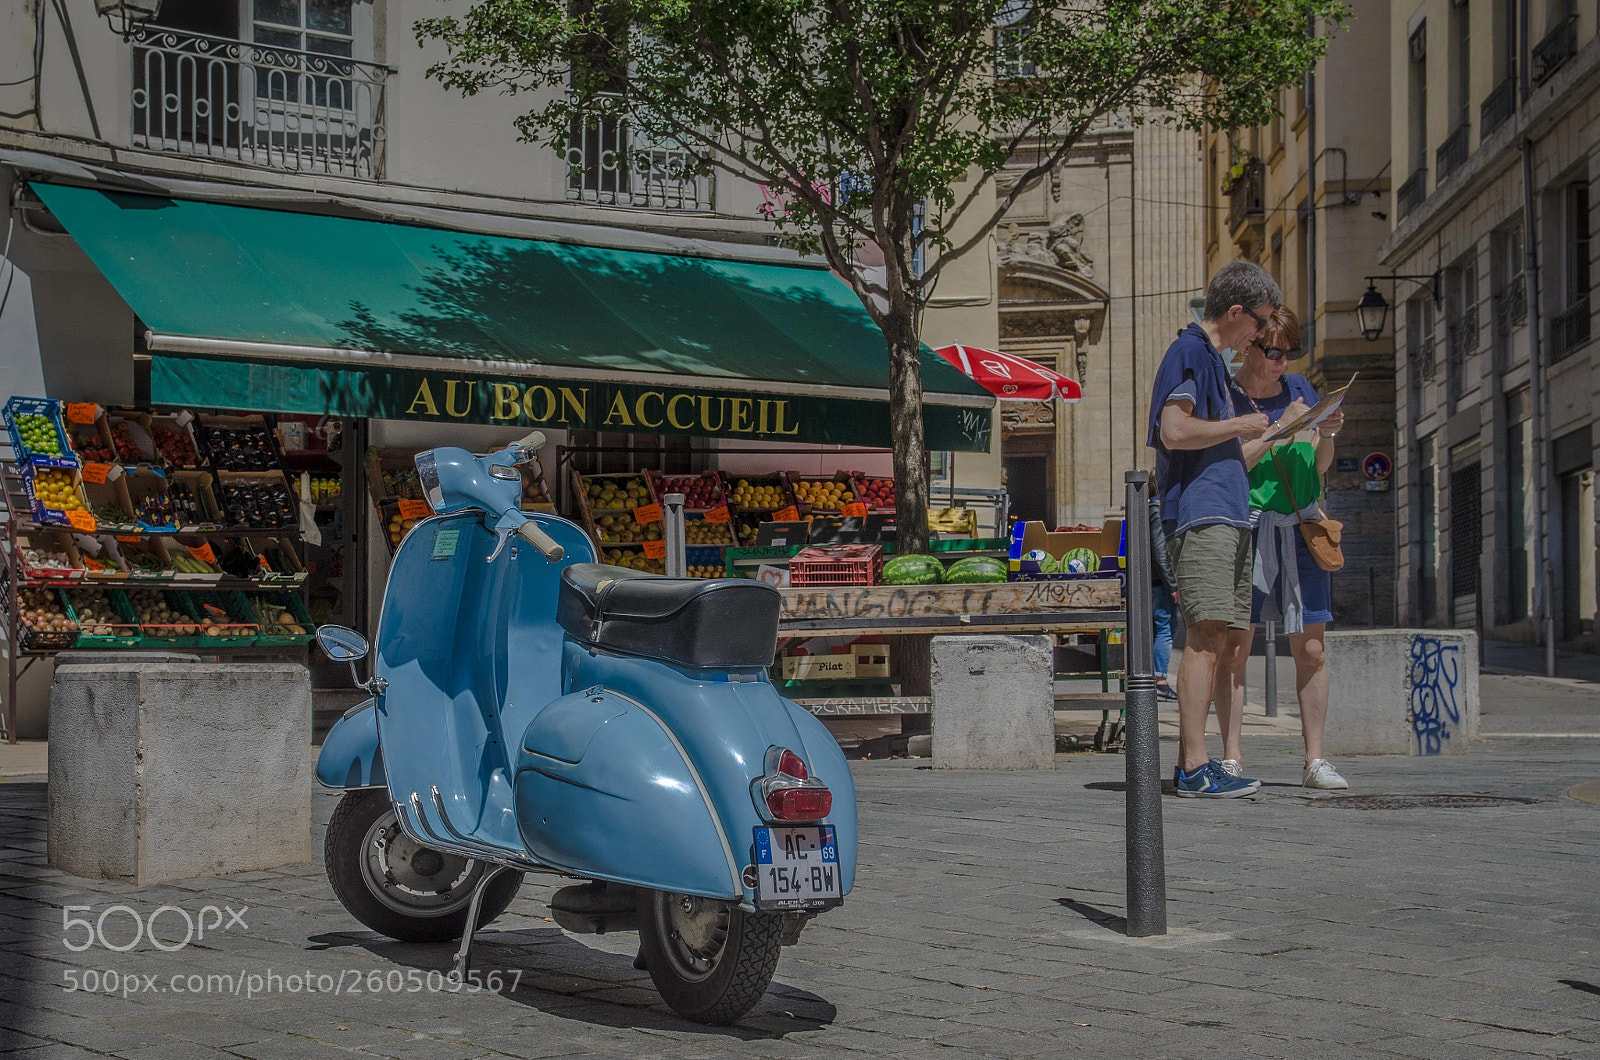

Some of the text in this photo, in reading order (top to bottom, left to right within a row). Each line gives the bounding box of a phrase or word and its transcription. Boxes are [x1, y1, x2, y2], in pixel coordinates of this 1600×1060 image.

[405, 377, 800, 436] AU BON ACCUEIL
[818, 662, 843, 671] Pilat
[761, 849, 767, 858] F
[823, 847, 834, 859] 69
[769, 866, 833, 893] 154-BW
